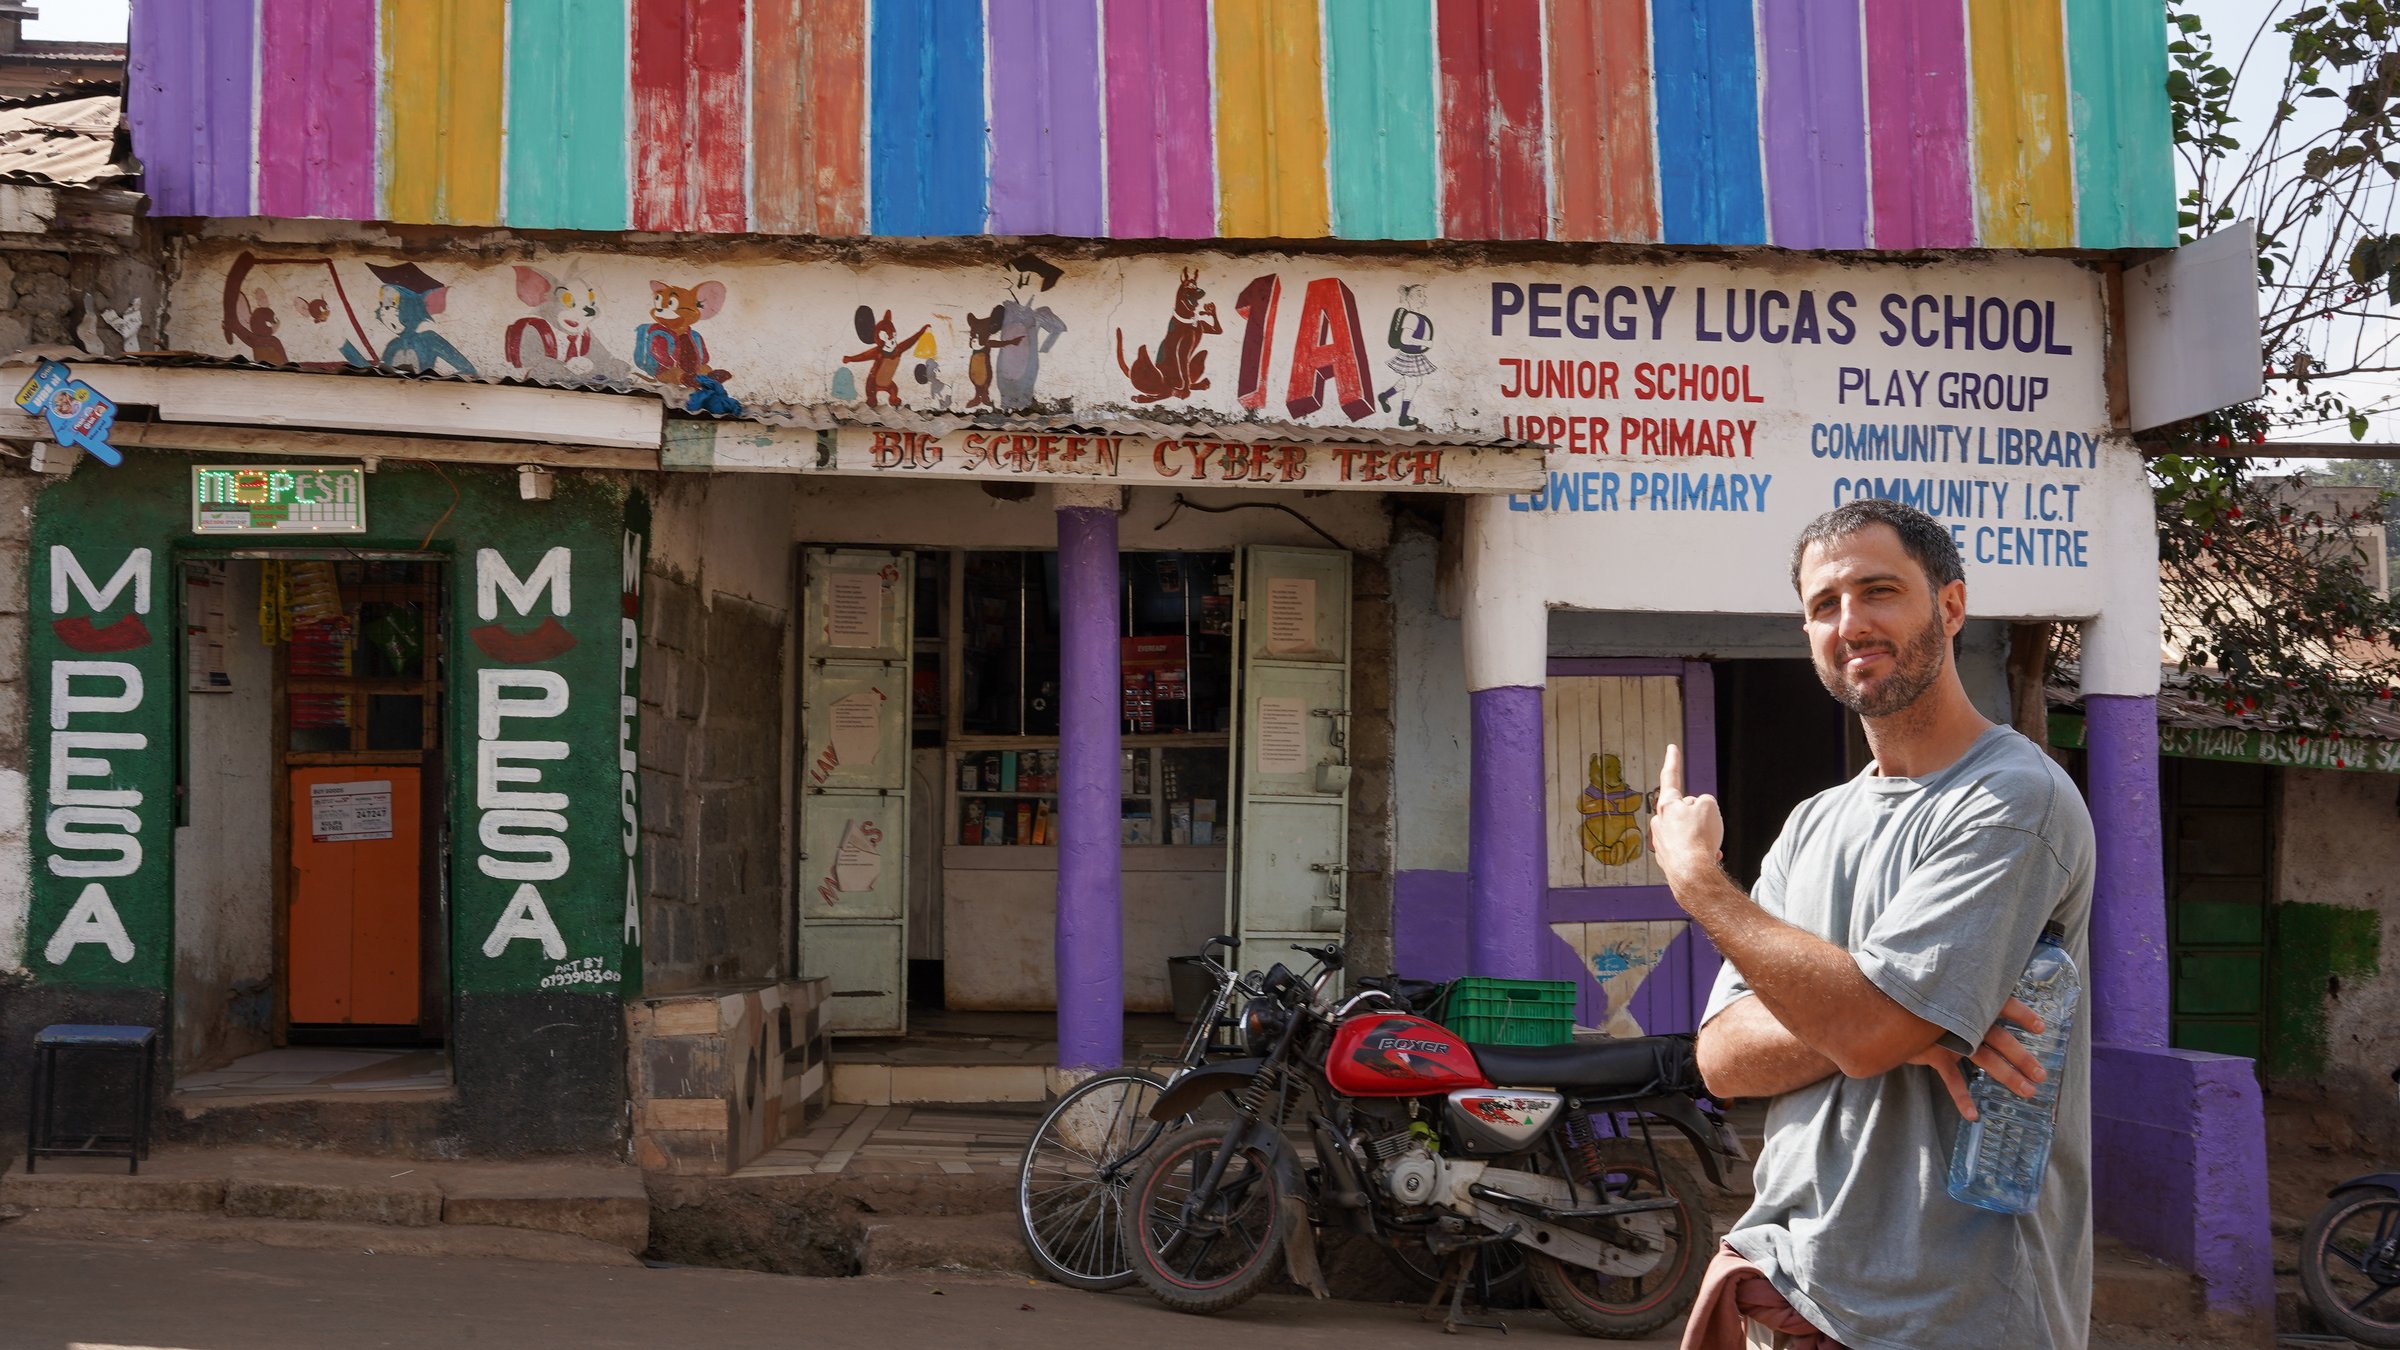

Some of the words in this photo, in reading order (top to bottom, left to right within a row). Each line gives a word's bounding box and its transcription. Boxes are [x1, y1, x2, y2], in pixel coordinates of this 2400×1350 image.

[1491, 282, 1676, 340] PEGGY
[1695, 286, 1857, 345] LUCAS
[1880, 293, 2072, 355] SCHOOL
[1235, 272, 1376, 423] 1A
[23, 382, 39, 402] NEW
[1499, 358, 1619, 400] JUNIOR
[1634, 361, 1764, 403] SCHOOL
[1838, 366, 1930, 408] PLAY
[1938, 371, 2049, 412] GROUP
[1503, 415, 1610, 454] UPPER
[1620, 416, 1757, 457] PRIMARY
[1811, 422, 1972, 463] COMMUNITY
[1978, 426, 2100, 468] LIBRARY
[868, 430, 943, 470] BIG
[1153, 439, 1308, 483] CYBER
[1332, 447, 1444, 486] TECH
[1630, 472, 1772, 512] PRIMARY
[1975, 525, 2089, 567] CENTRE
[2197, 730, 2249, 757] HAIR
[554, 959, 581, 974] ART
[583, 955, 603, 969] BY
[1378, 1037, 1450, 1055] BOXER
